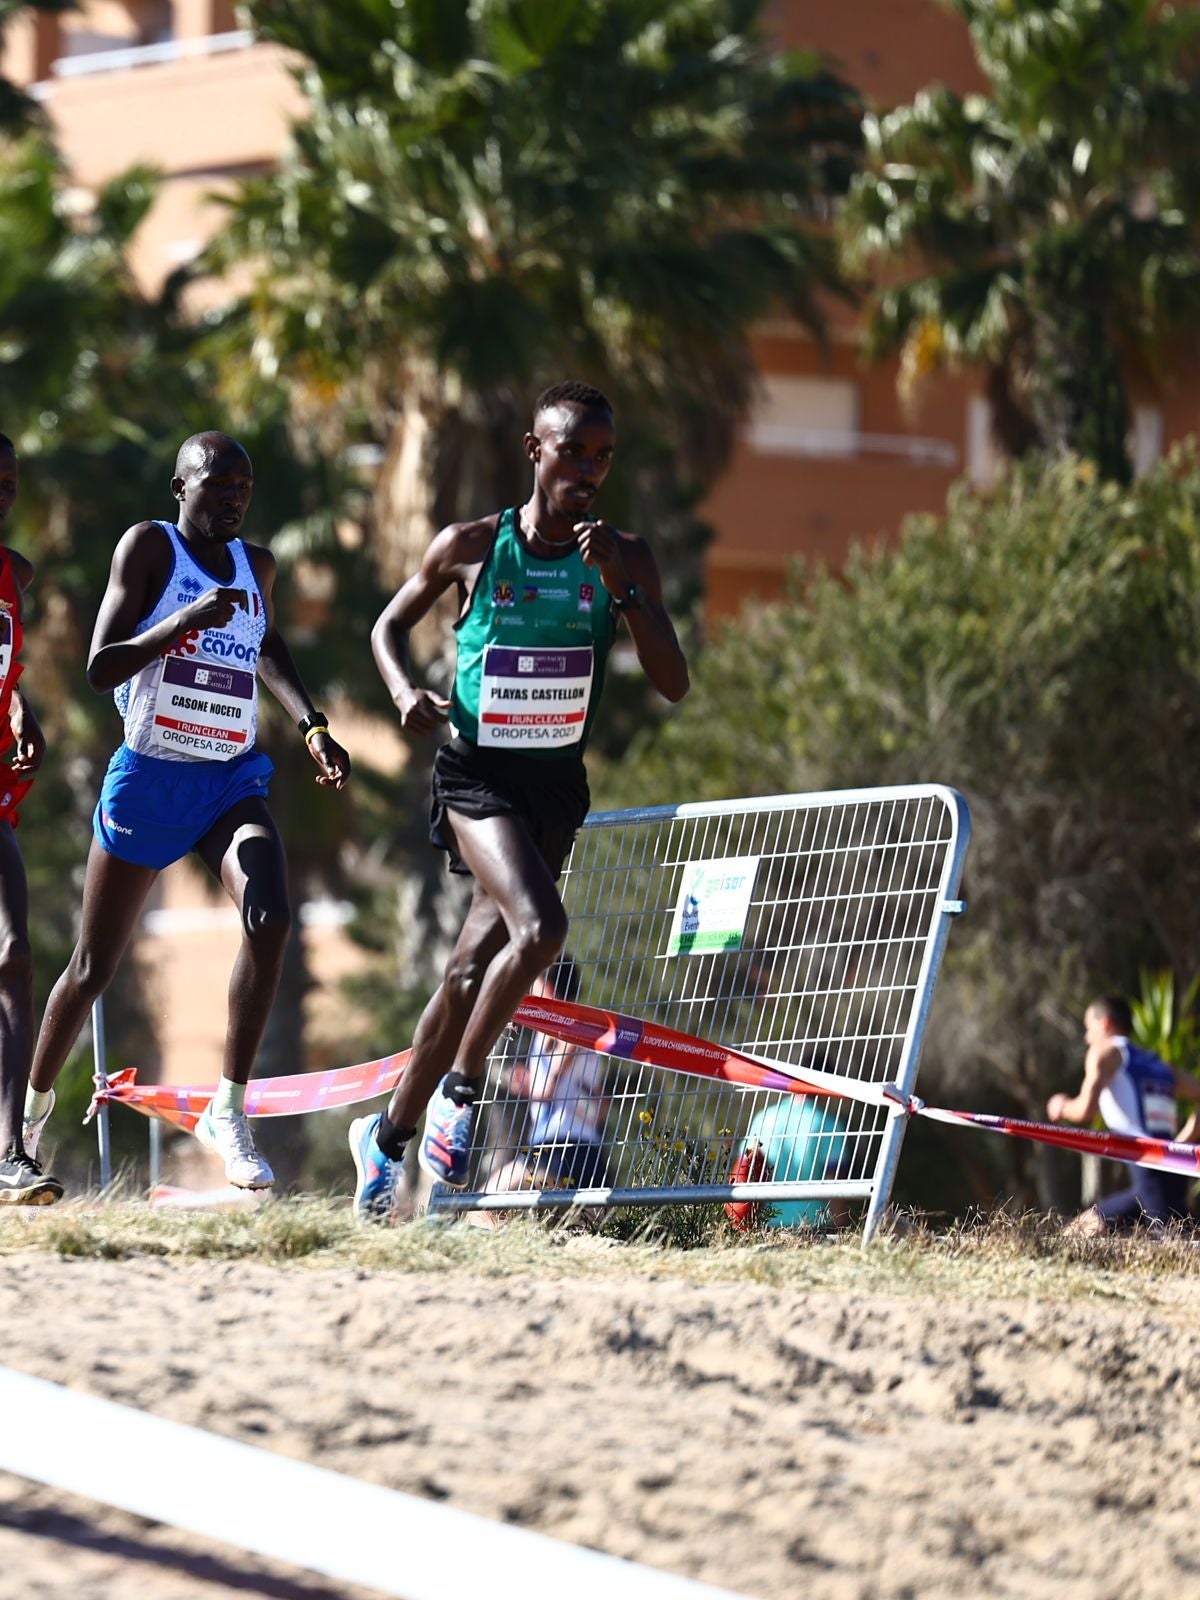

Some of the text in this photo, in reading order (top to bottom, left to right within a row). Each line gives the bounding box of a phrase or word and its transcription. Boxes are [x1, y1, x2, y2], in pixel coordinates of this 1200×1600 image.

[203, 630, 235, 641] ATLETICA
[491, 687, 585, 700] PLAYAS CASTELLON
[171, 694, 242, 719] CASONE NOCETO
[512, 716, 533, 724] RUN
[535, 715, 566, 725] CLEAN
[181, 723, 202, 734] RUN
[202, 727, 229, 739] CLEAN
[491, 727, 549, 739] OROPESA
[163, 730, 237, 755] OROPESA 2023
[643, 1035, 668, 1048] EUROPEAN
[667, 1040, 705, 1056] CHAMPIONSHIPS
